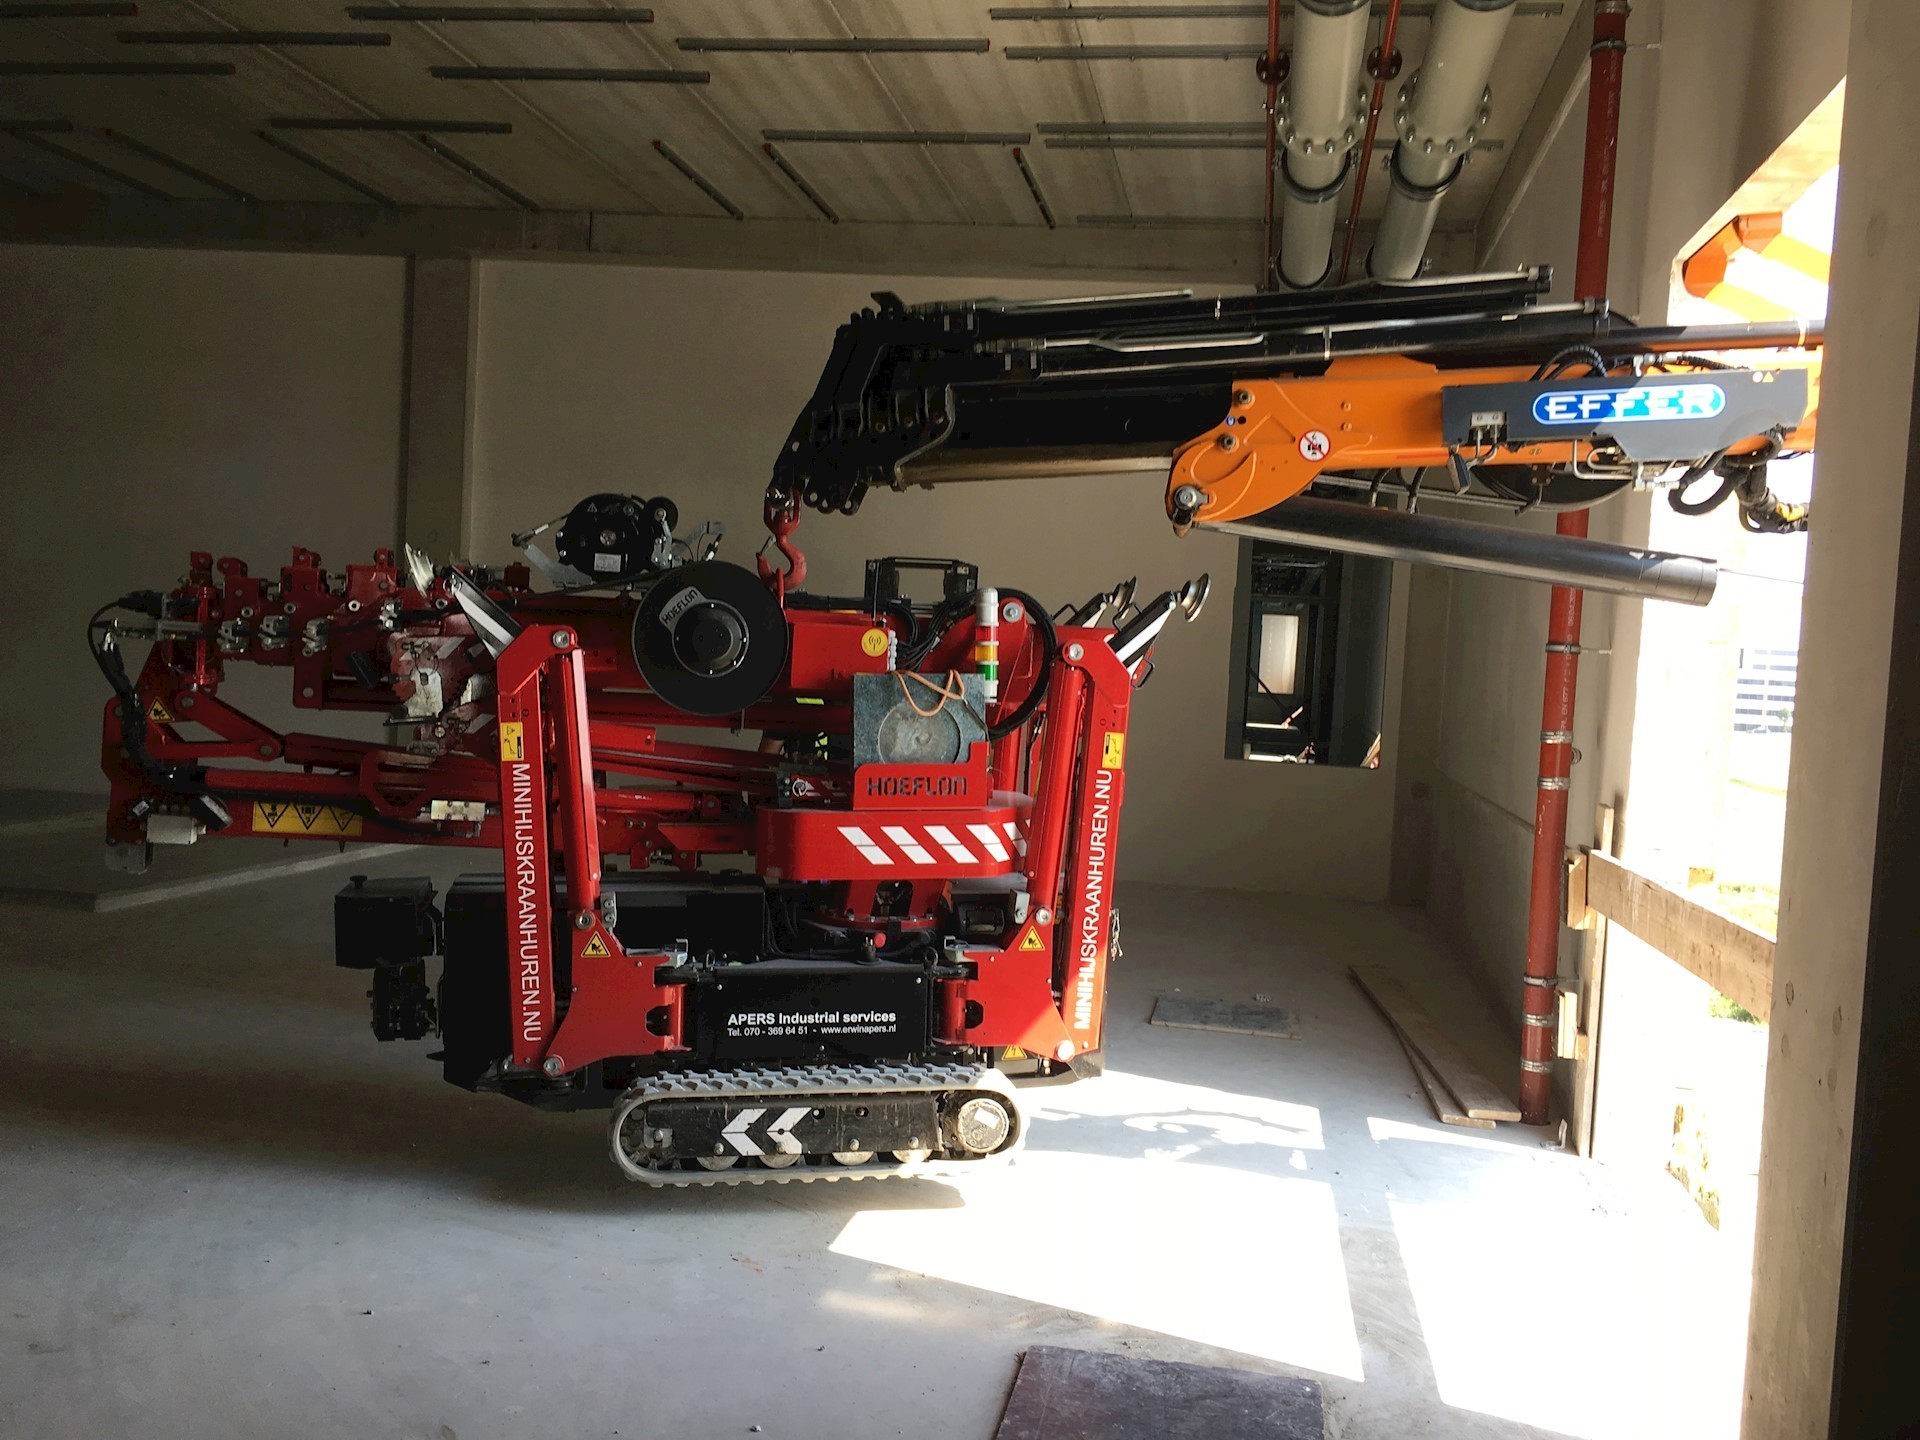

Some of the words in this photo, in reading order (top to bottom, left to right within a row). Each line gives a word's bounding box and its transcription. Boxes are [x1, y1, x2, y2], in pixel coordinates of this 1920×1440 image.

[1544, 389, 1715, 420] EFFER
[661, 589, 698, 625] HOEFLON
[868, 776, 967, 796] HOEFLON
[512, 763, 541, 1042] MINIHIJSKRAANHUREN.NU
[1074, 770, 1113, 1030] MINIHIJSKRAANHUREN.NU
[727, 1013, 776, 1026] APERS
[778, 1011, 840, 1025] Industrial
[842, 1010, 897, 1023] services
[727, 1027, 743, 1037] Tel.
[743, 1026, 761, 1036] 070
[767, 1025, 784, 1036] 369
[785, 1025, 796, 1035] 64
[797, 1025, 808, 1035] 51
[821, 1024, 896, 1034] www.erwinapers.nl
